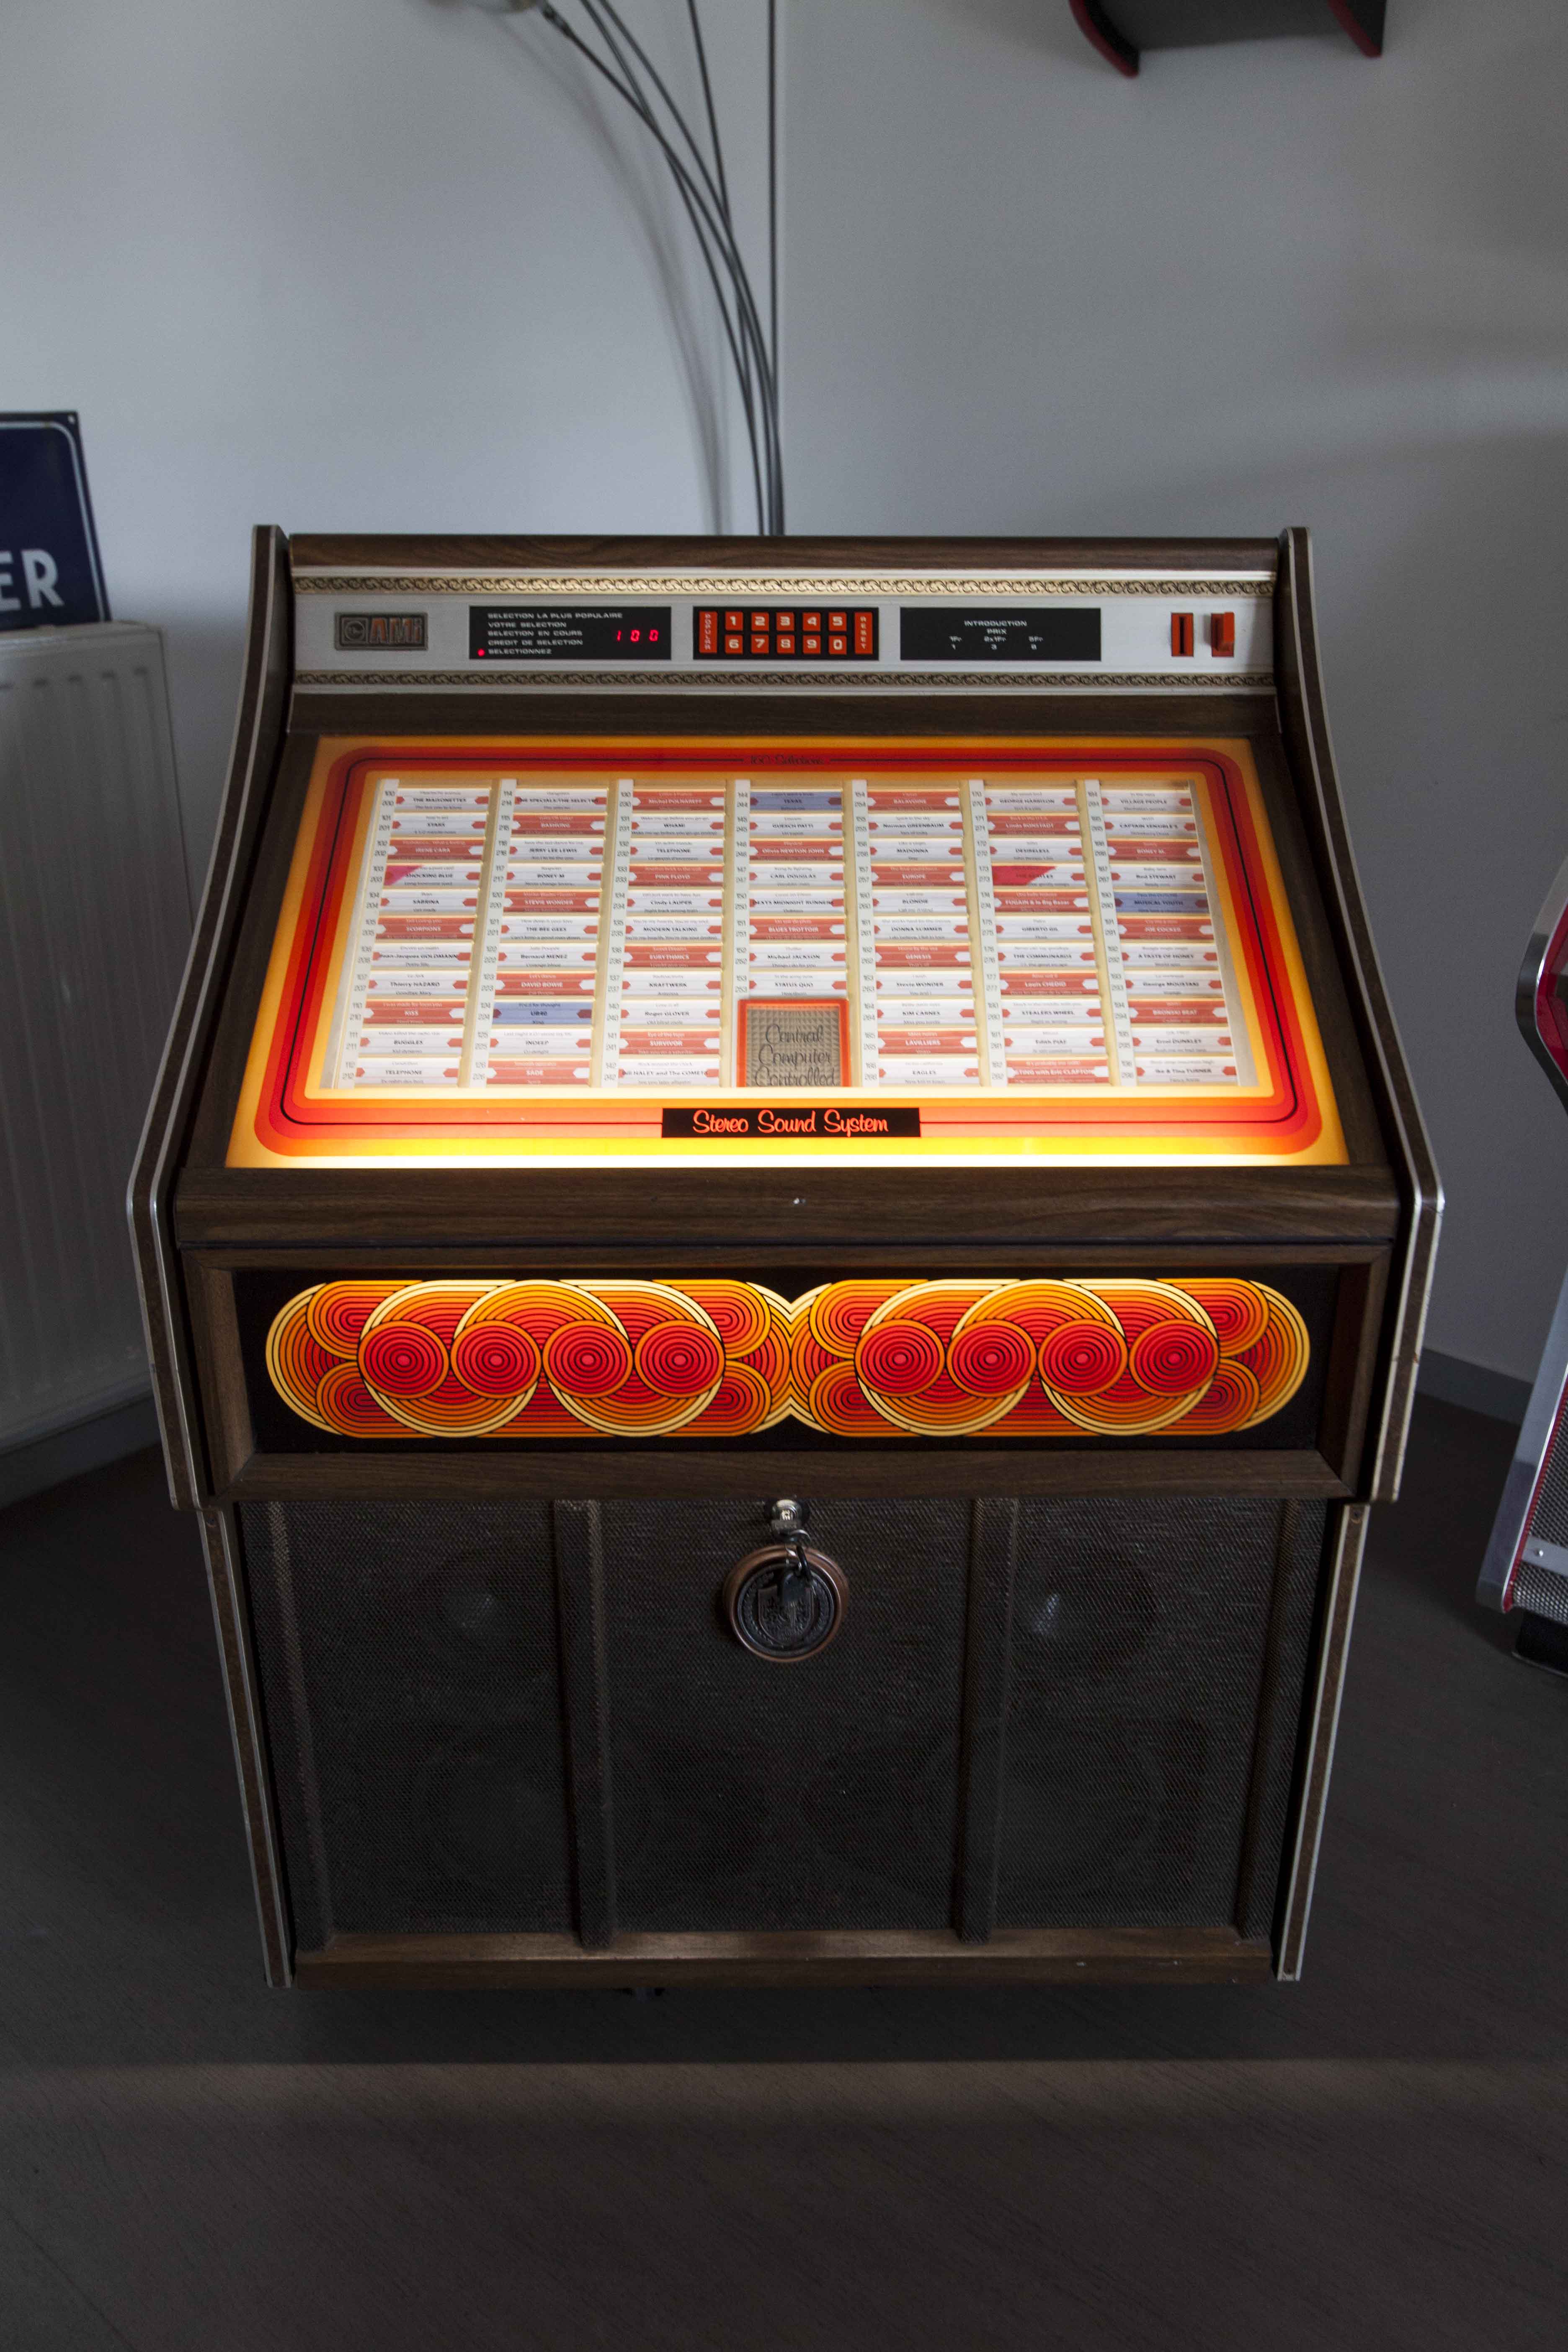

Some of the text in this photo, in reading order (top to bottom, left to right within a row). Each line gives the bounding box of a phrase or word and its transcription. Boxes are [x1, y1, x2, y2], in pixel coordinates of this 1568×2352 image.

[730, 616, 736, 625] 1
[755, 616, 765, 626] 2
[780, 616, 790, 626] 3
[807, 616, 817, 625] 4
[832, 616, 843, 626] 5
[729, 639, 739, 648] 6
[755, 639, 765, 648] 7
[781, 639, 791, 648] 8
[807, 639, 817, 648] 9
[833, 639, 842, 650] 0
[766, 1024, 823, 1044] Central
[758, 1045, 831, 1069] Computer
[755, 1066, 835, 1086] Controlled
[693, 1110, 888, 1137] Stereo Sound System
